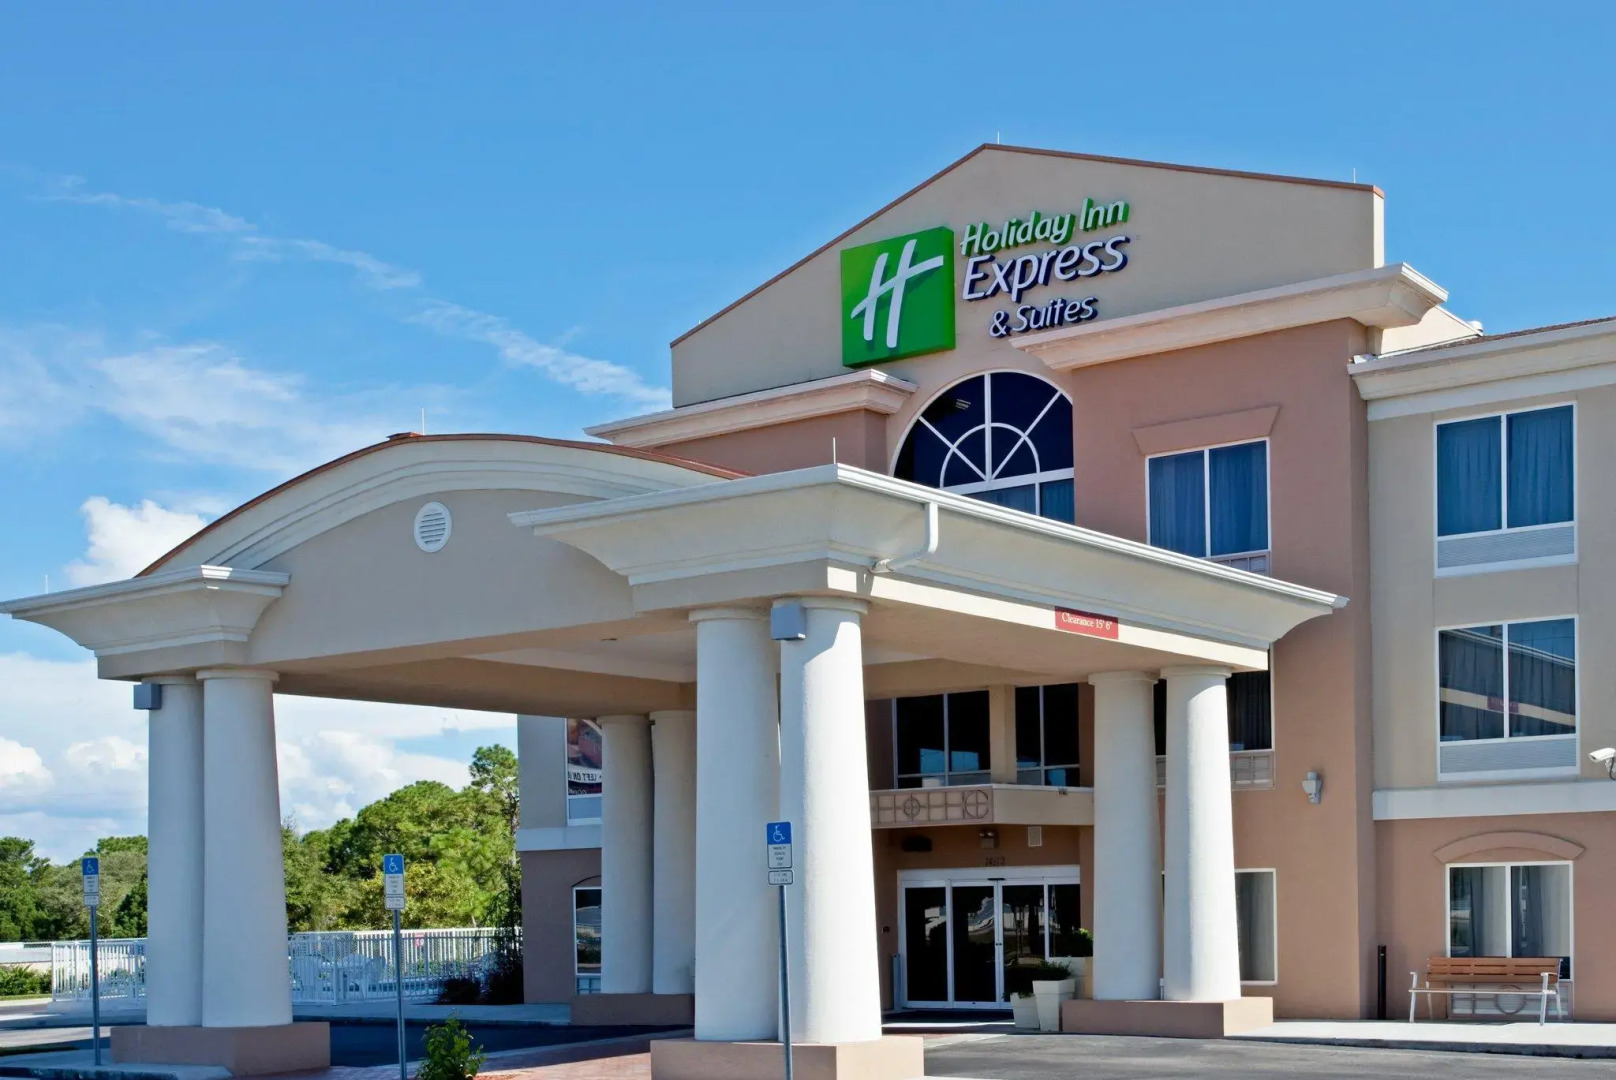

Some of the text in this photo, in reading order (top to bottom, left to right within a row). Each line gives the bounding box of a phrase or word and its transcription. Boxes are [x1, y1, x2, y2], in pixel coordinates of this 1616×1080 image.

[960, 197, 1130, 256] Holiday Inn
[962, 236, 1130, 303] Express
[989, 296, 1098, 338] & Suites
[1062, 612, 1094, 627] Clearance
